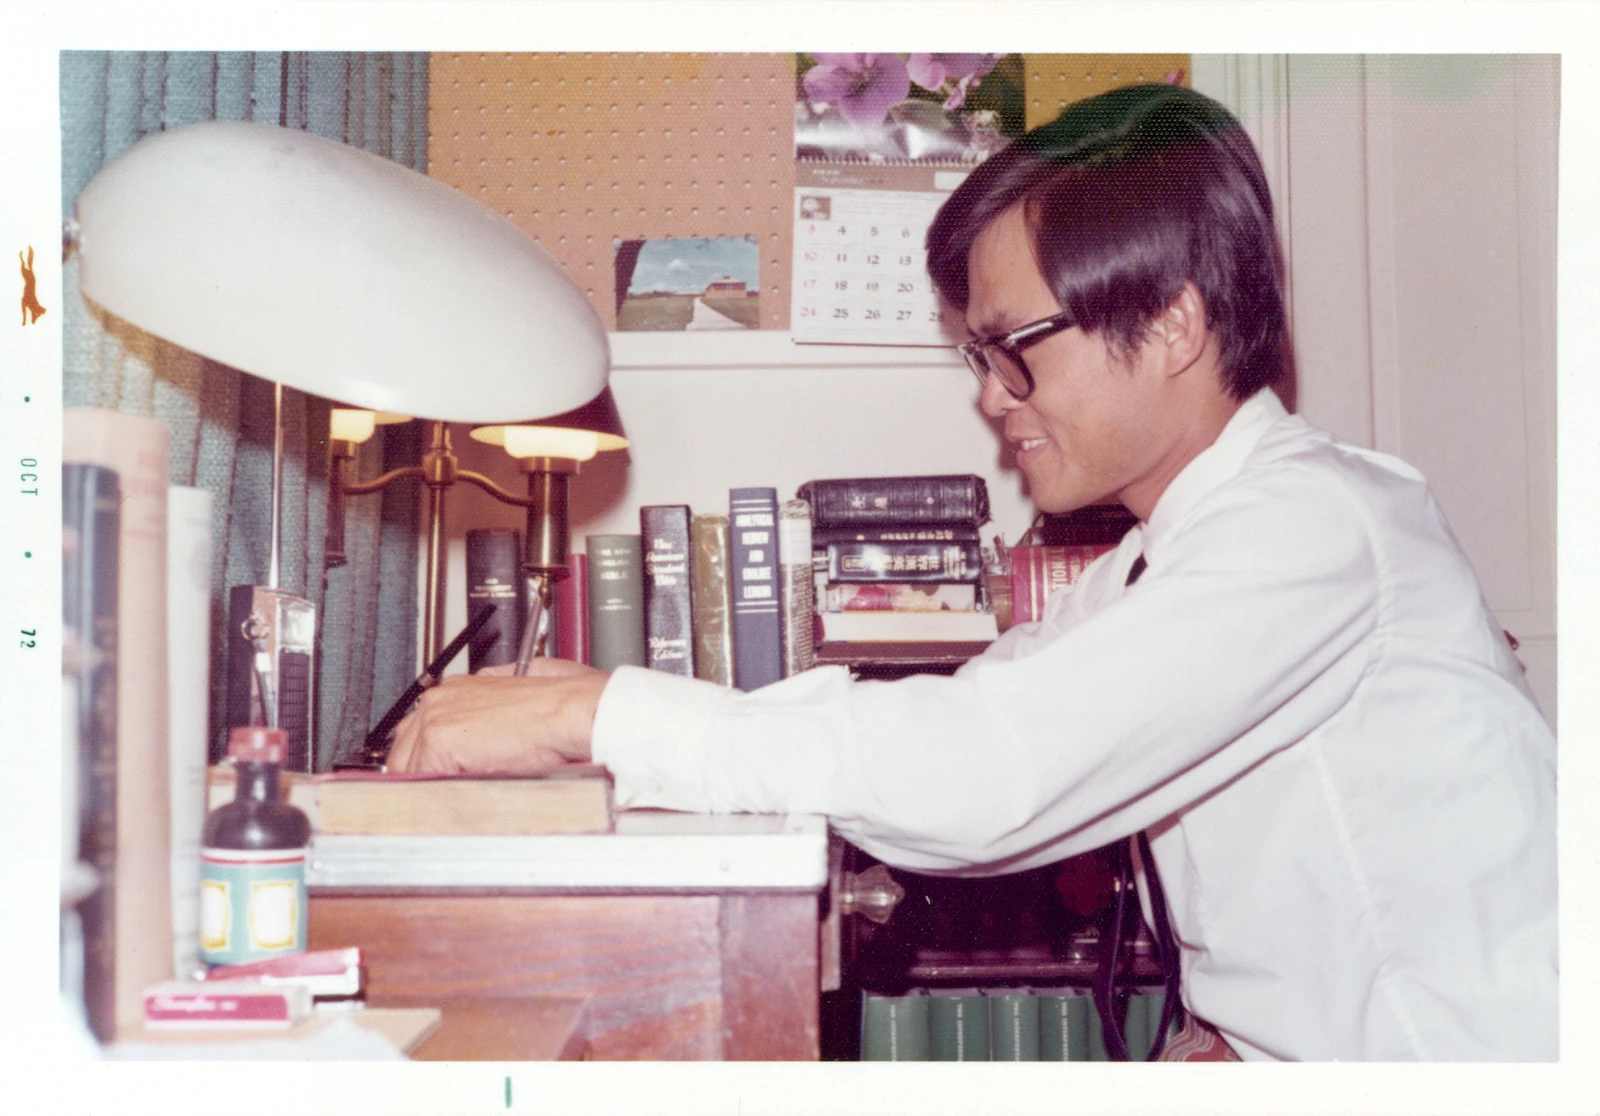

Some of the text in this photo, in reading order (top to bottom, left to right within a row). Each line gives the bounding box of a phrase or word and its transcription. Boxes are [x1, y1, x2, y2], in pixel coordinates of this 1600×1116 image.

[808, 223, 910, 238] 3 4 5 6
[804, 251, 912, 266] 10 11 12 13
[803, 279, 913, 293] 17 18 19 20
[800, 307, 944, 323] 24 25 26 27 28
[748, 549, 765, 562] AND
[600, 571, 627, 580] BIBLE
